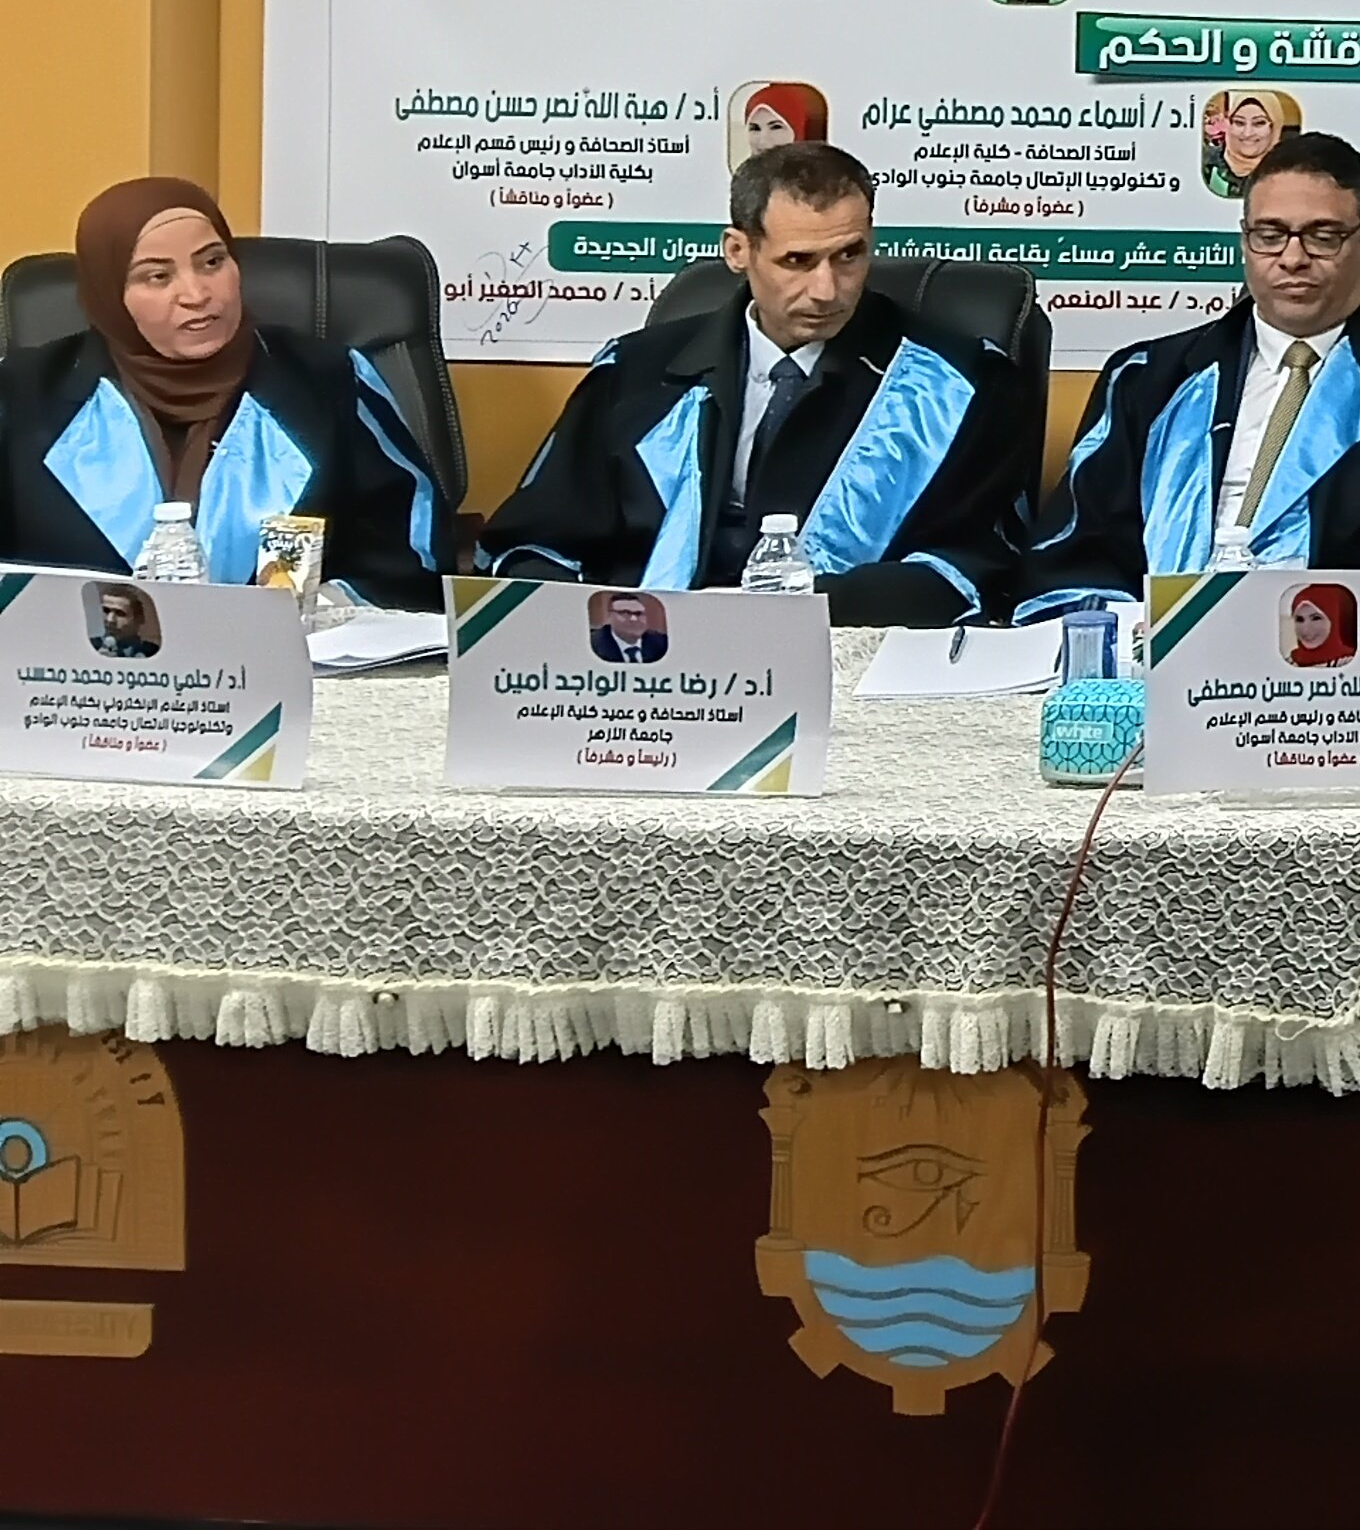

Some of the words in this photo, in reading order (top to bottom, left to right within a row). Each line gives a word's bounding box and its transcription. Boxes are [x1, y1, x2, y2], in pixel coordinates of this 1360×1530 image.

[1098, 27, 1222, 70] الحكم
[395, 88, 479, 121] مصطفى
[485, 89, 538, 123] حسن
[542, 91, 579, 124] نصر
[624, 92, 668, 126] هبة
[693, 86, 719, 121] أ.د
[862, 96, 912, 130] عرام
[1078, 93, 1145, 130] أسماء
[1169, 94, 1195, 129] أ.د
[918, 98, 1005, 137] مصطفي
[1010, 106, 1072, 129] محمد
[417, 133, 471, 154] الإعلام
[474, 135, 516, 154] قسم
[519, 134, 561, 156] رئيس
[579, 136, 644, 153] الصحافة
[647, 134, 690, 154] أستاذ
[913, 143, 970, 164] الإعلام
[973, 143, 1011, 163] كلية
[1025, 144, 1091, 161] الصحافة
[1094, 141, 1136, 161] أستاذ
[452, 157, 500, 180] أسوان
[504, 161, 555, 179] جامعة
[609, 163, 653, 184] بكلية
[921, 169, 966, 189] جنوب
[969, 169, 1023, 190] جامعة
[1026, 170, 1082, 192] الإتصال
[1085, 171, 1166, 192] تكنولوجيا
[572, 235, 657, 262] الجديدة
[988, 243, 1050, 268] بقاعة
[1119, 241, 1167, 270] عشر
[1173, 242, 1235, 270] الثانية
[444, 273, 473, 302] أبو
[547, 285, 607, 302] محمد
[1046, 289, 1122, 314] المنعم
[1126, 295, 1162, 314] عبد
[493, 661, 549, 696] أمين
[554, 670, 627, 697] الواجد
[632, 676, 674, 700] عبد
[679, 671, 718, 701] رضا
[743, 667, 773, 698] أ.د
[1260, 675, 1305, 704] حسن
[1306, 674, 1338, 702] نصر
[1186, 677, 1259, 709] مصطفى
